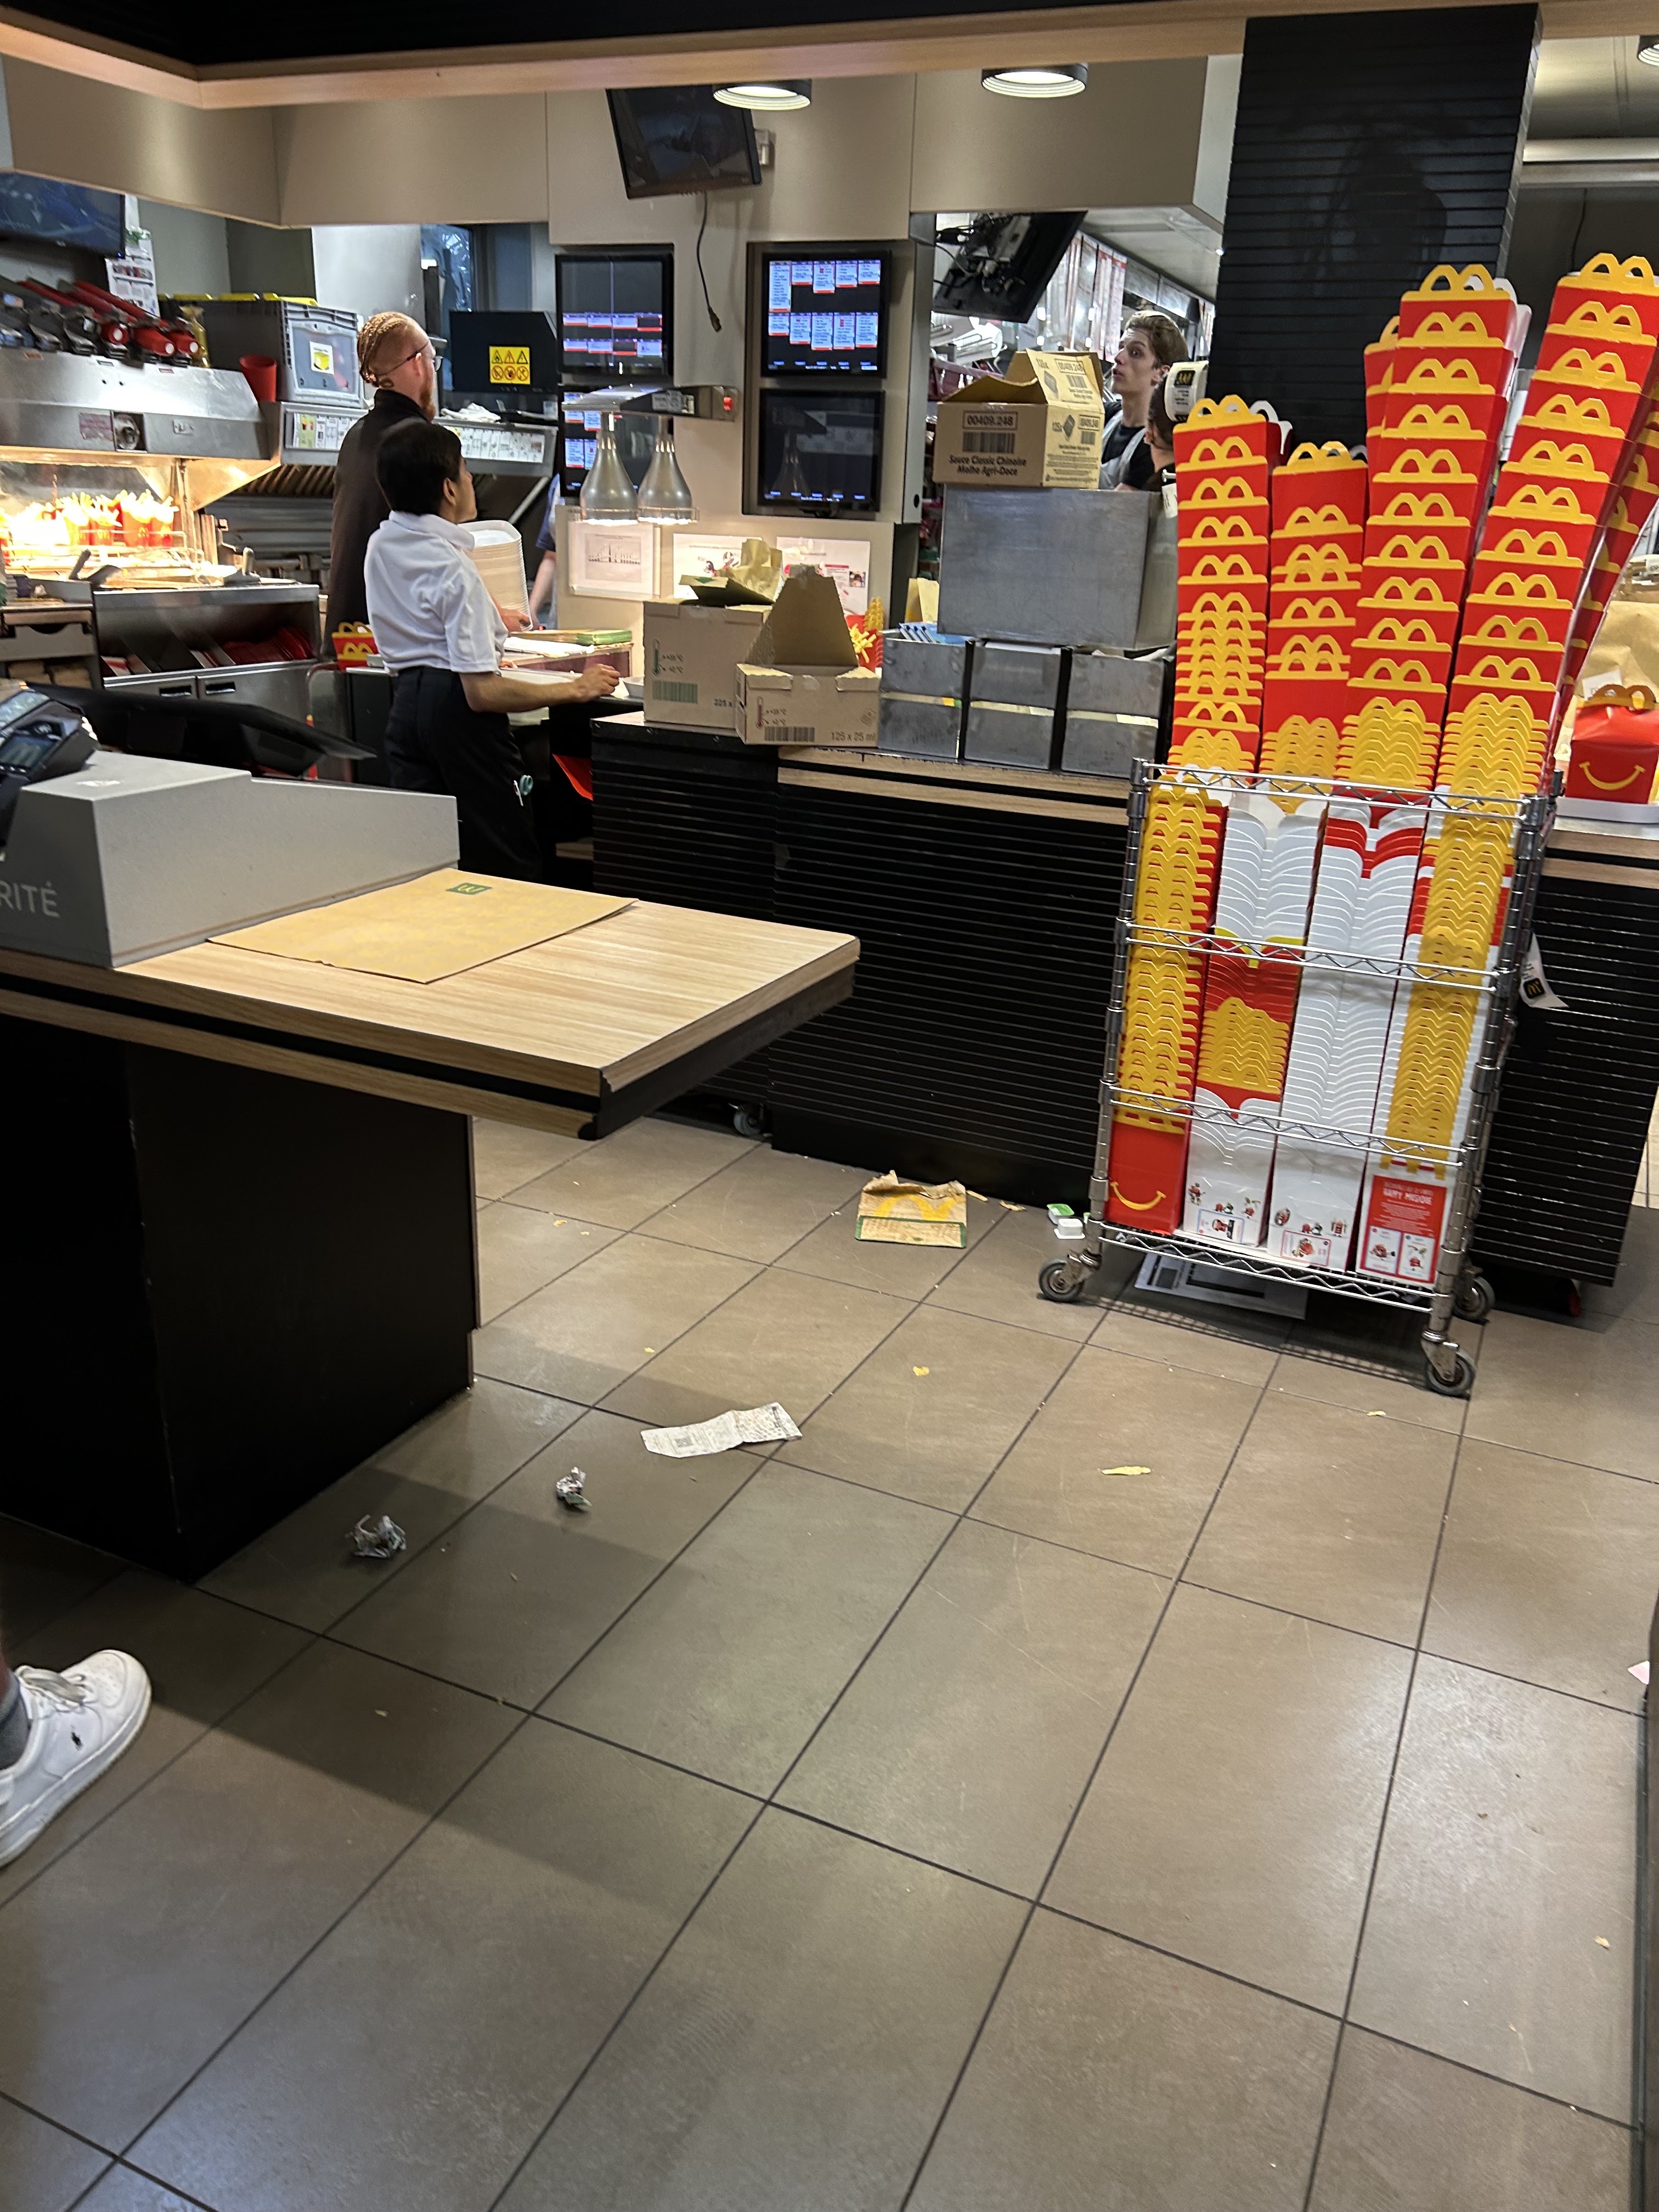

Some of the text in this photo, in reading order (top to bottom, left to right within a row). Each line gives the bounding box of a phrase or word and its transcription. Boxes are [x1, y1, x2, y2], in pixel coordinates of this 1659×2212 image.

[967, 415, 1013, 426] 00409.248
[949, 454, 970, 464] Sauce
[831, 731, 845, 741] 125
[853, 731, 865, 741] 25
